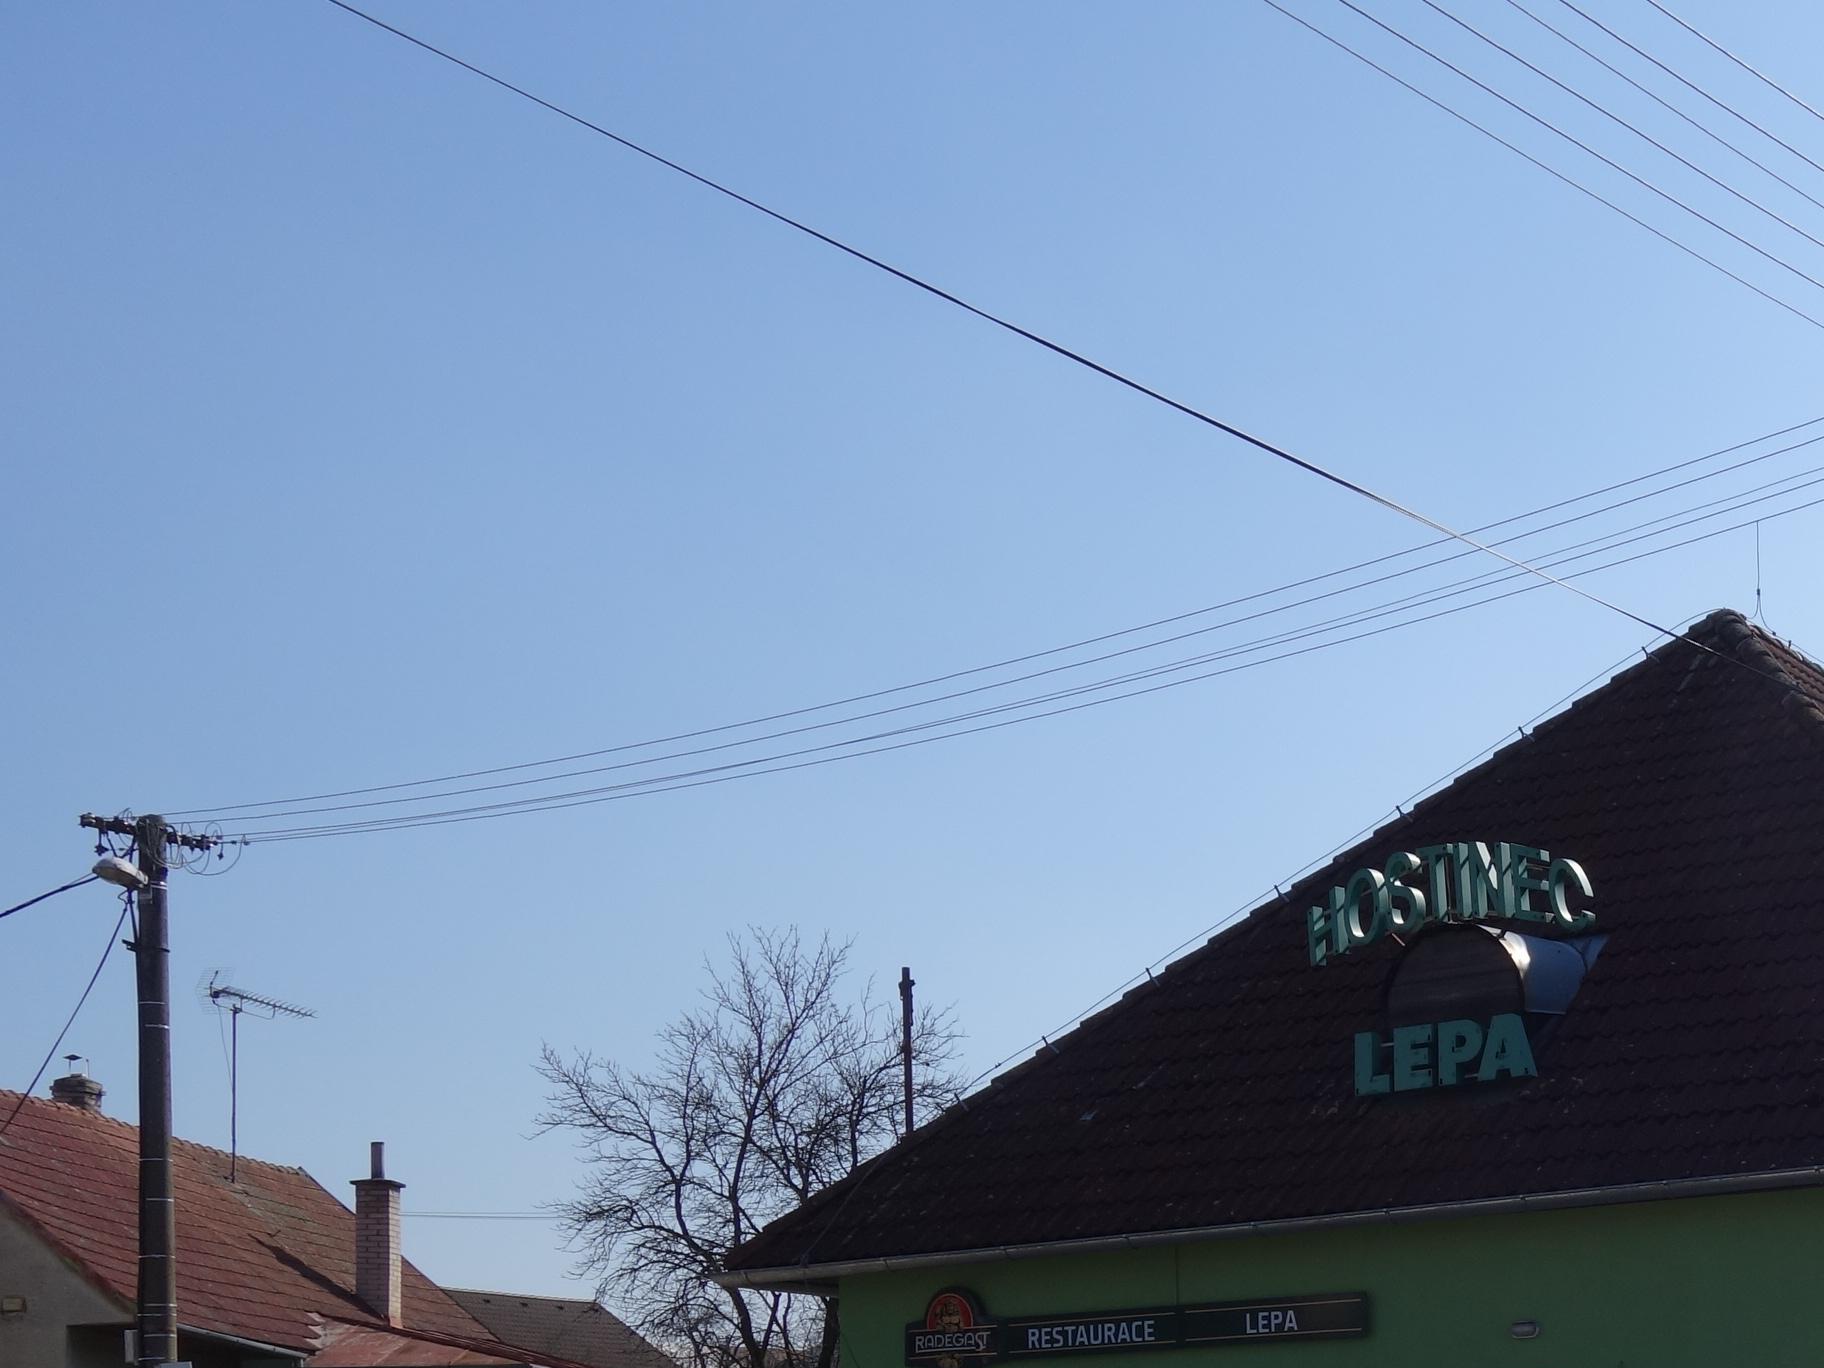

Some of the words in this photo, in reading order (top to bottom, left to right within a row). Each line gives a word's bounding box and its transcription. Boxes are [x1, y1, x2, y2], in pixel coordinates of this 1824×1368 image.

[1307, 841, 1596, 967] HOSTINEC
[1354, 1013, 1538, 1096] LEPA
[914, 1331, 992, 1353] RADEGAST
[1028, 1320, 1155, 1349] RESTAURACE
[1245, 1310, 1298, 1335] LEPA
